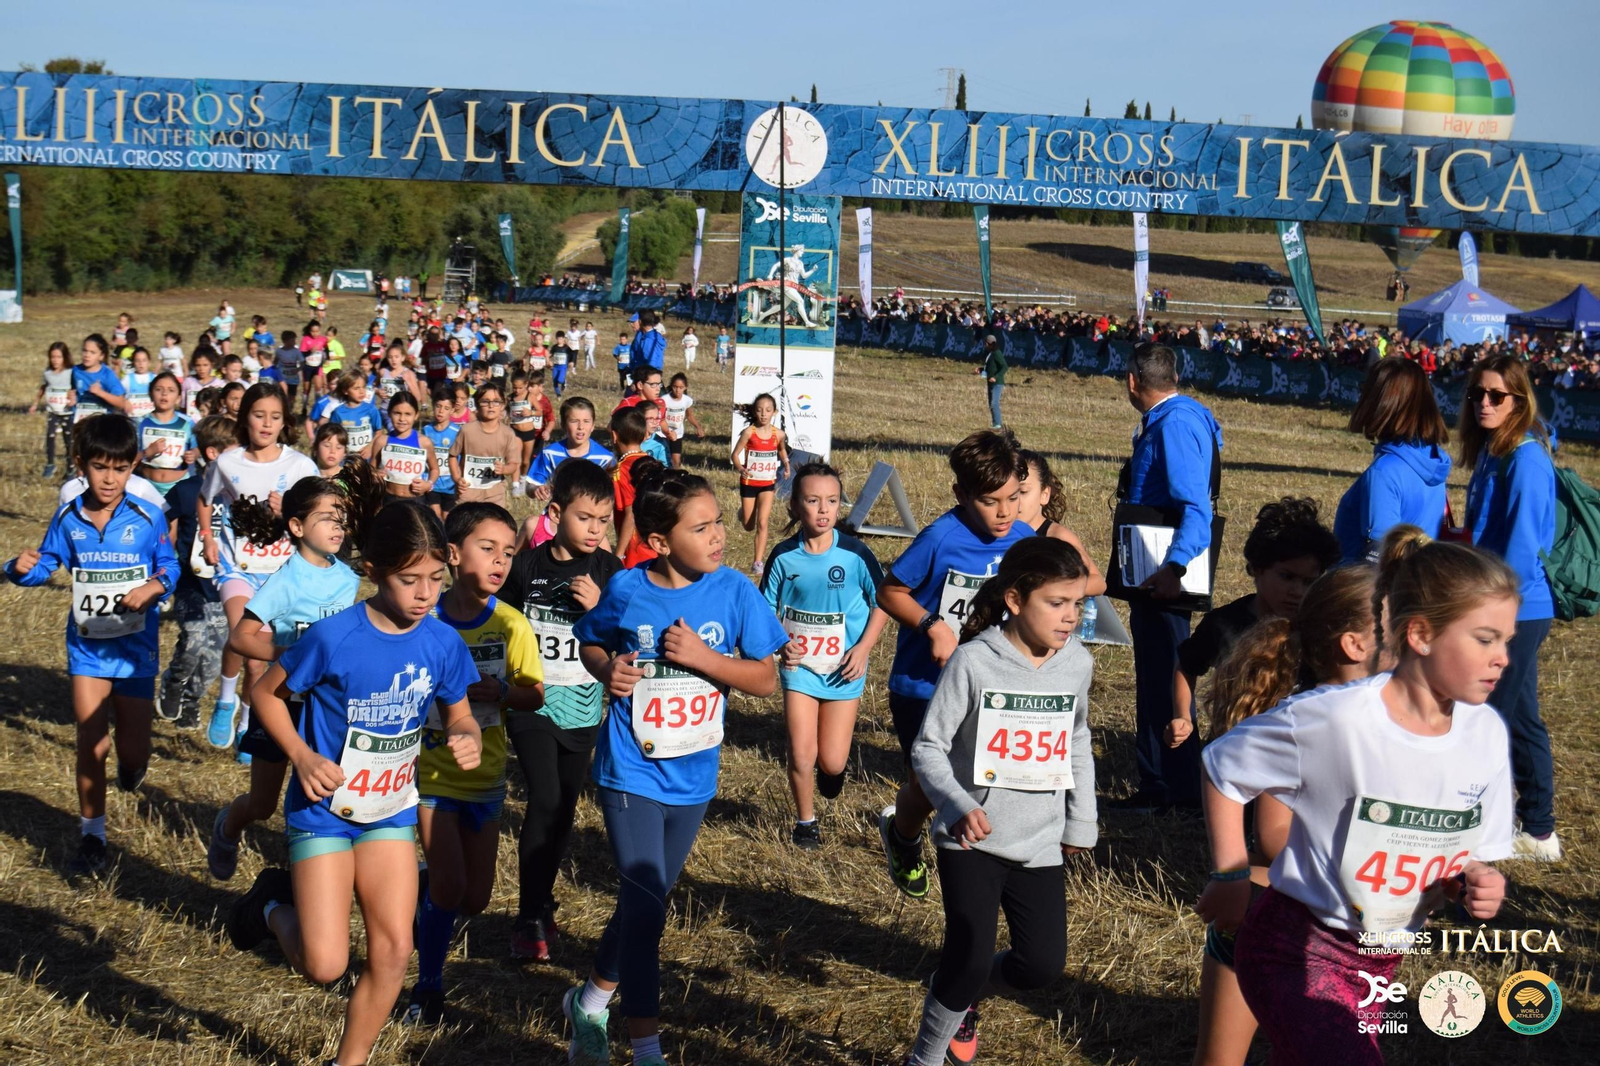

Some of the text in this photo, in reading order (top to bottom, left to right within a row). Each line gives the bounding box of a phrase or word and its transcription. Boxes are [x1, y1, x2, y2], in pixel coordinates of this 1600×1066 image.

[0, 86, 129, 144] LIII
[133, 91, 266, 128] CROSS
[326, 87, 644, 169] ITÁLICA
[1443, 115, 1473, 137] Hay
[133, 128, 312, 151] INTERNACIONAL
[873, 119, 1041, 181] XLIII
[1045, 128, 1177, 168] CROSS
[122, 149, 183, 168] CROSS
[185, 152, 281, 171] COUNTRY
[1044, 165, 1221, 191] INTERNACIONAL
[1233, 130, 1546, 216] ITÁLICA
[871, 177, 1189, 211] INTERNATIONAL CROSS COUNTRY
[792, 213, 828, 224] Sevilla
[348, 435, 371, 447] 102
[385, 458, 423, 475] 4480
[751, 462, 777, 472] 4344
[78, 551, 140, 563] OTASIERRA
[92, 571, 130, 582] ITÁLICA
[796, 613, 828, 624] ITÁLICA
[642, 690, 721, 729] 4397
[1013, 695, 1058, 709] ITÁLICA
[378, 734, 417, 751] ITÁLICA
[986, 728, 1068, 763] 4354
[1399, 809, 1463, 829] ITÁLICA
[1403, 840, 1429, 848] VICENTE
[1354, 850, 1470, 896] 4506
